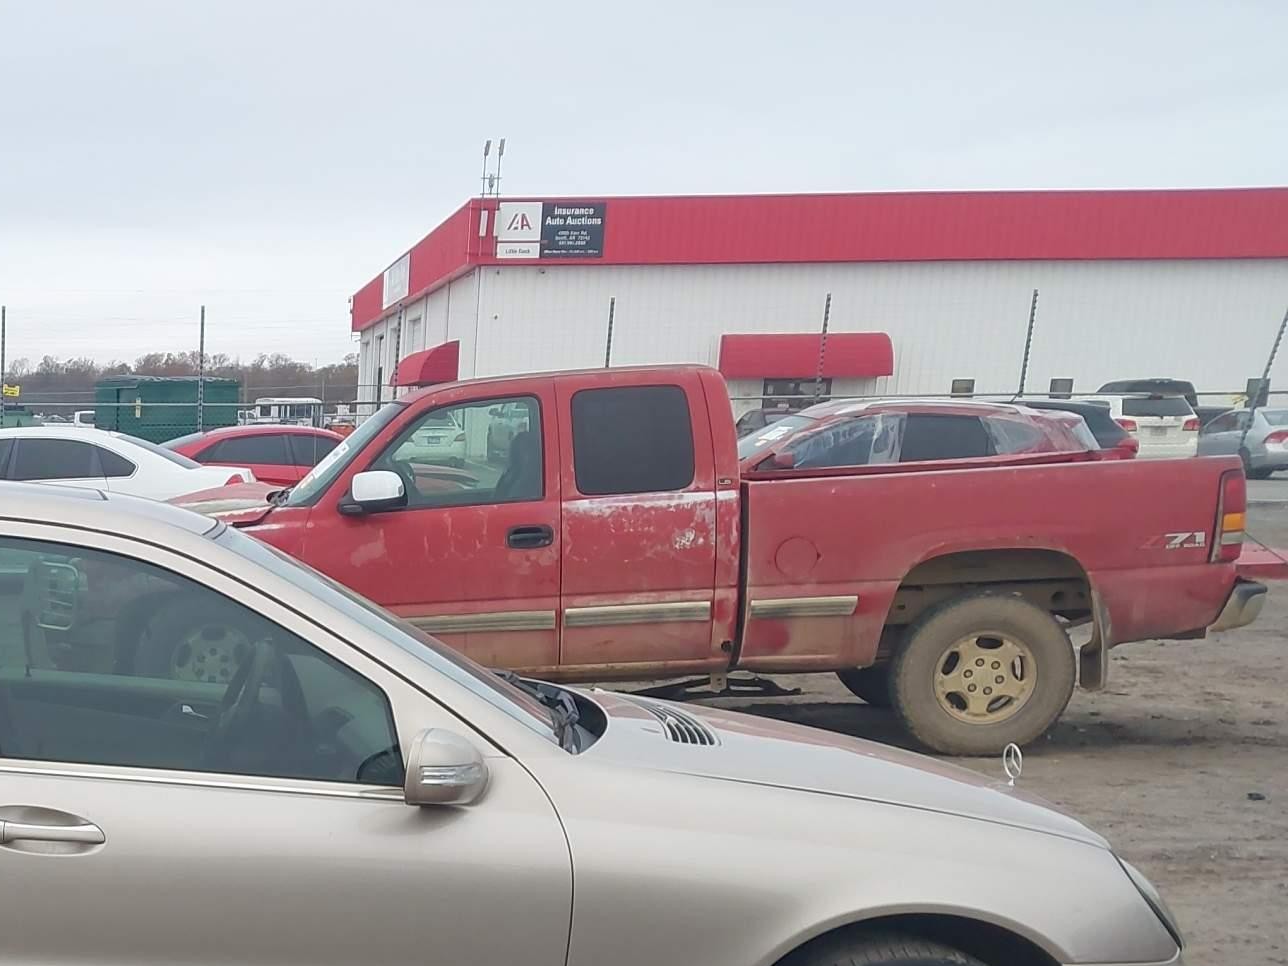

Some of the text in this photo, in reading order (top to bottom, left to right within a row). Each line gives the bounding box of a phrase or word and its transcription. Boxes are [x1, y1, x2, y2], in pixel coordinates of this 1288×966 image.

[554, 205, 594, 215] Insurance
[545, 216, 602, 225] Auto Auctions
